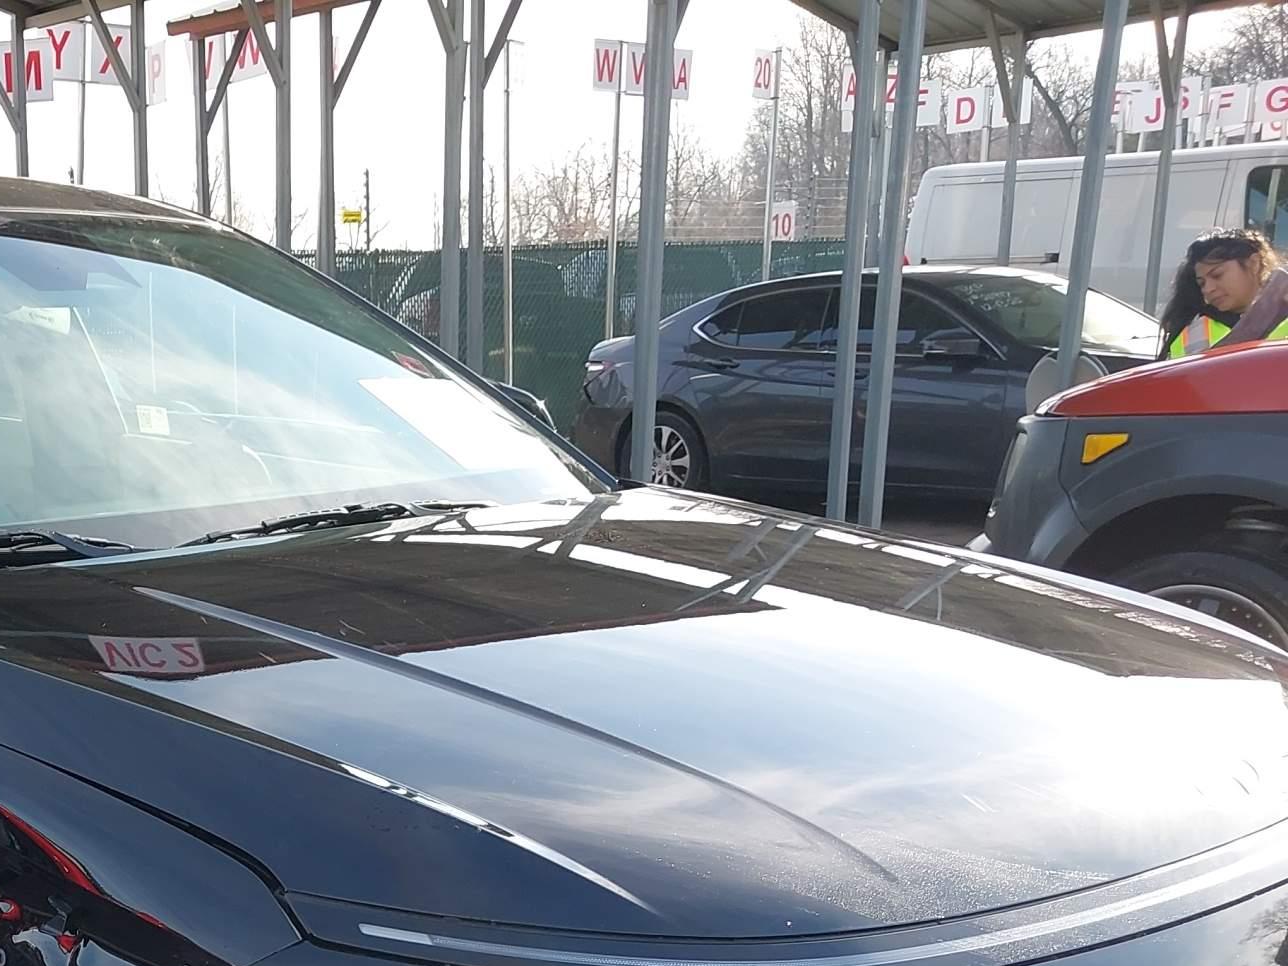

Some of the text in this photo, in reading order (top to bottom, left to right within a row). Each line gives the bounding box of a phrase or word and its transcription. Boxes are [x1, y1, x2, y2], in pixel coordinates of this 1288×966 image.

[46, 27, 71, 70] Y
[596, 48, 617, 83] W
[753, 56, 771, 90] 20
[955, 96, 976, 125] D
[1144, 97, 1161, 124] J
[1265, 85, 1288, 113] G
[772, 212, 792, 237] 10
